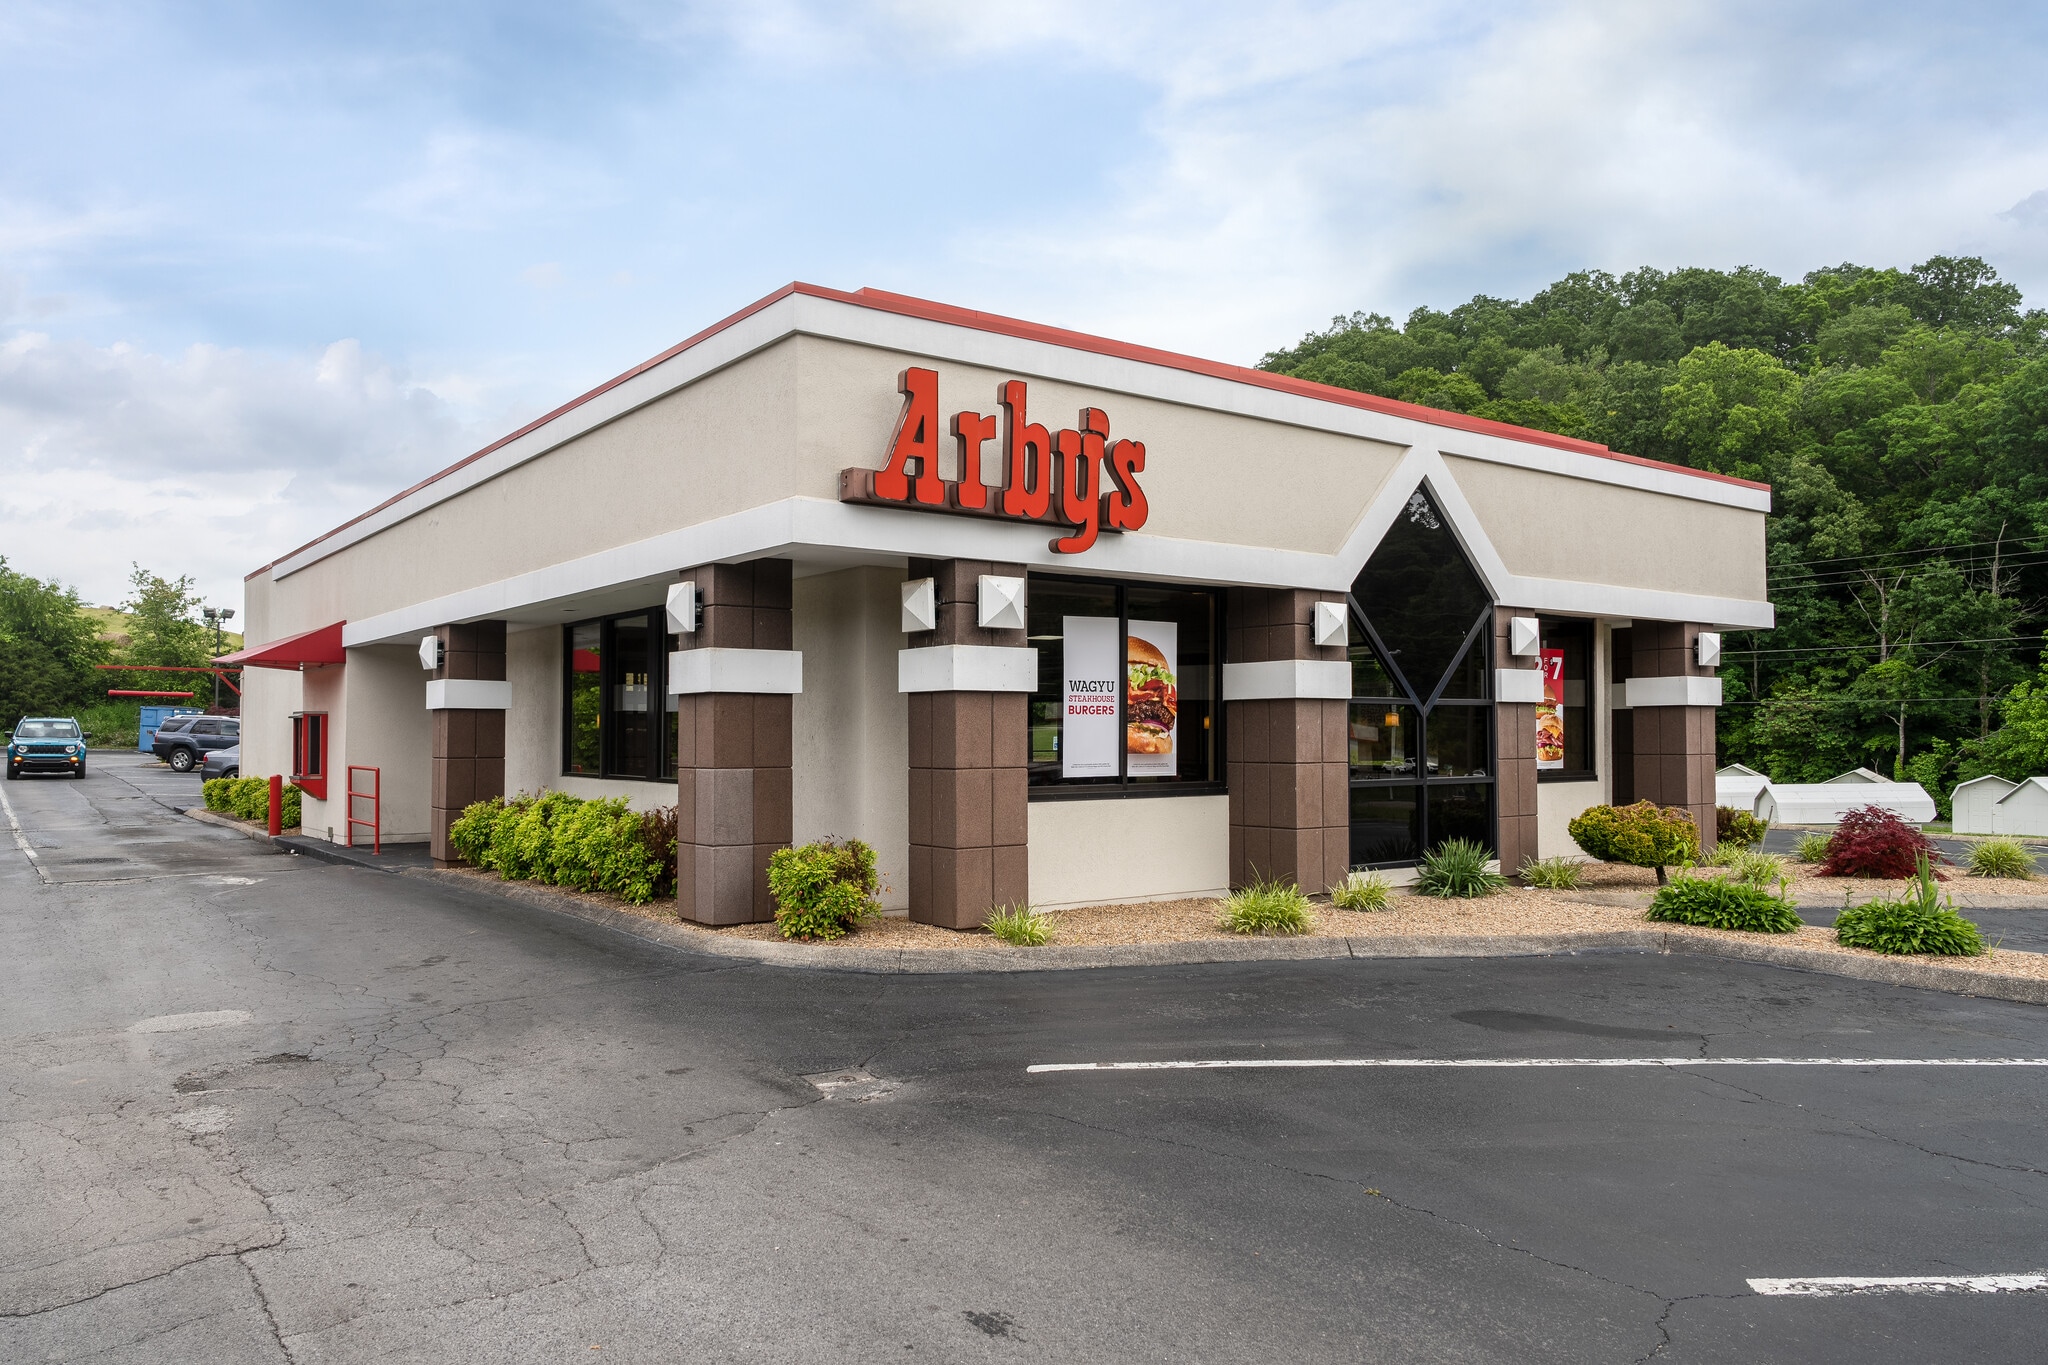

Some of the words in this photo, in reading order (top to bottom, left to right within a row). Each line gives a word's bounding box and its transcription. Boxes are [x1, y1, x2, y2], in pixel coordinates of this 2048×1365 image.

[870, 366, 1149, 554] Arby's
[1068, 680, 1115, 693] WAGYU
[1068, 694, 1115, 703] STEAKHOUSE
[1068, 705, 1115, 715] BURGERS
